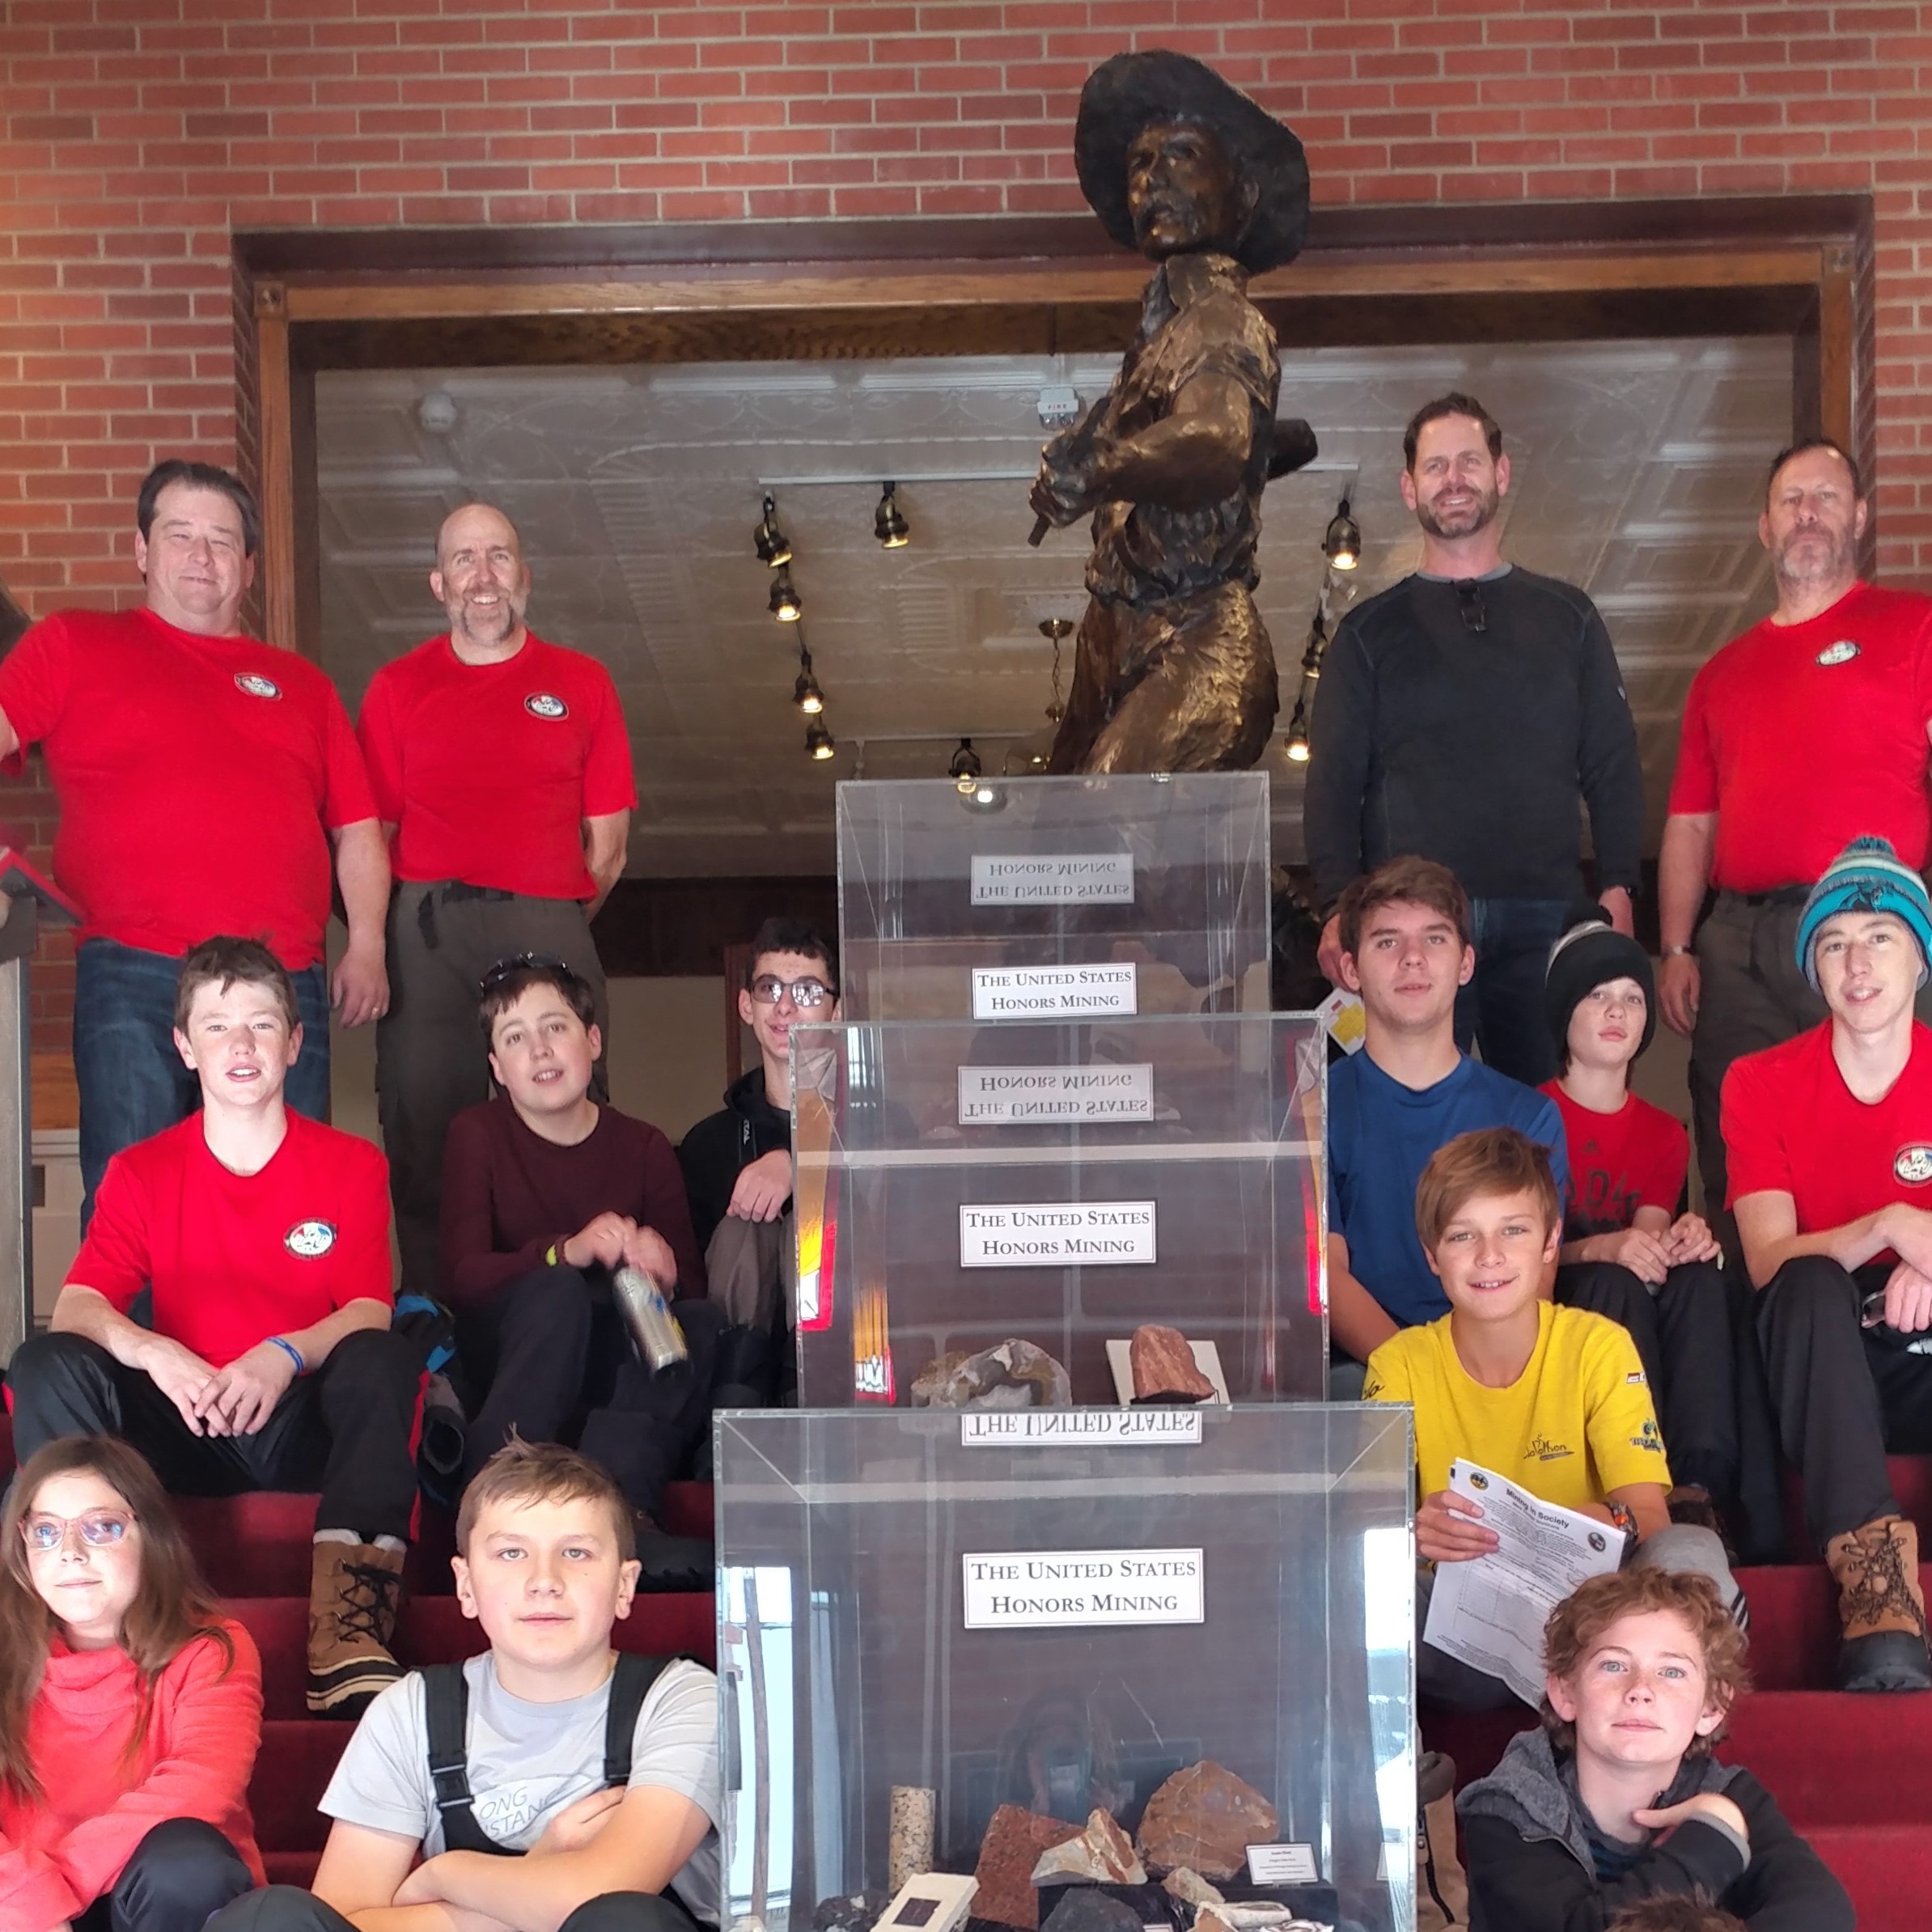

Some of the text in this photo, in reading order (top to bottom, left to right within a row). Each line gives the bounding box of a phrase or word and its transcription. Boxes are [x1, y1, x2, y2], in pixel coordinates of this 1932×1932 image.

[977, 971, 1132, 988] THE UNITED STATES
[991, 994, 1120, 1010] HONORS MINING
[966, 1210, 1150, 1228] THE UNITED STATES
[981, 1238, 1135, 1255] HONORS MINING
[1506, 1488, 1570, 1529] Mining in Society
[971, 1560, 1196, 1580] THE UNITED STATES
[990, 1594, 1178, 1614] HONORS MINING
